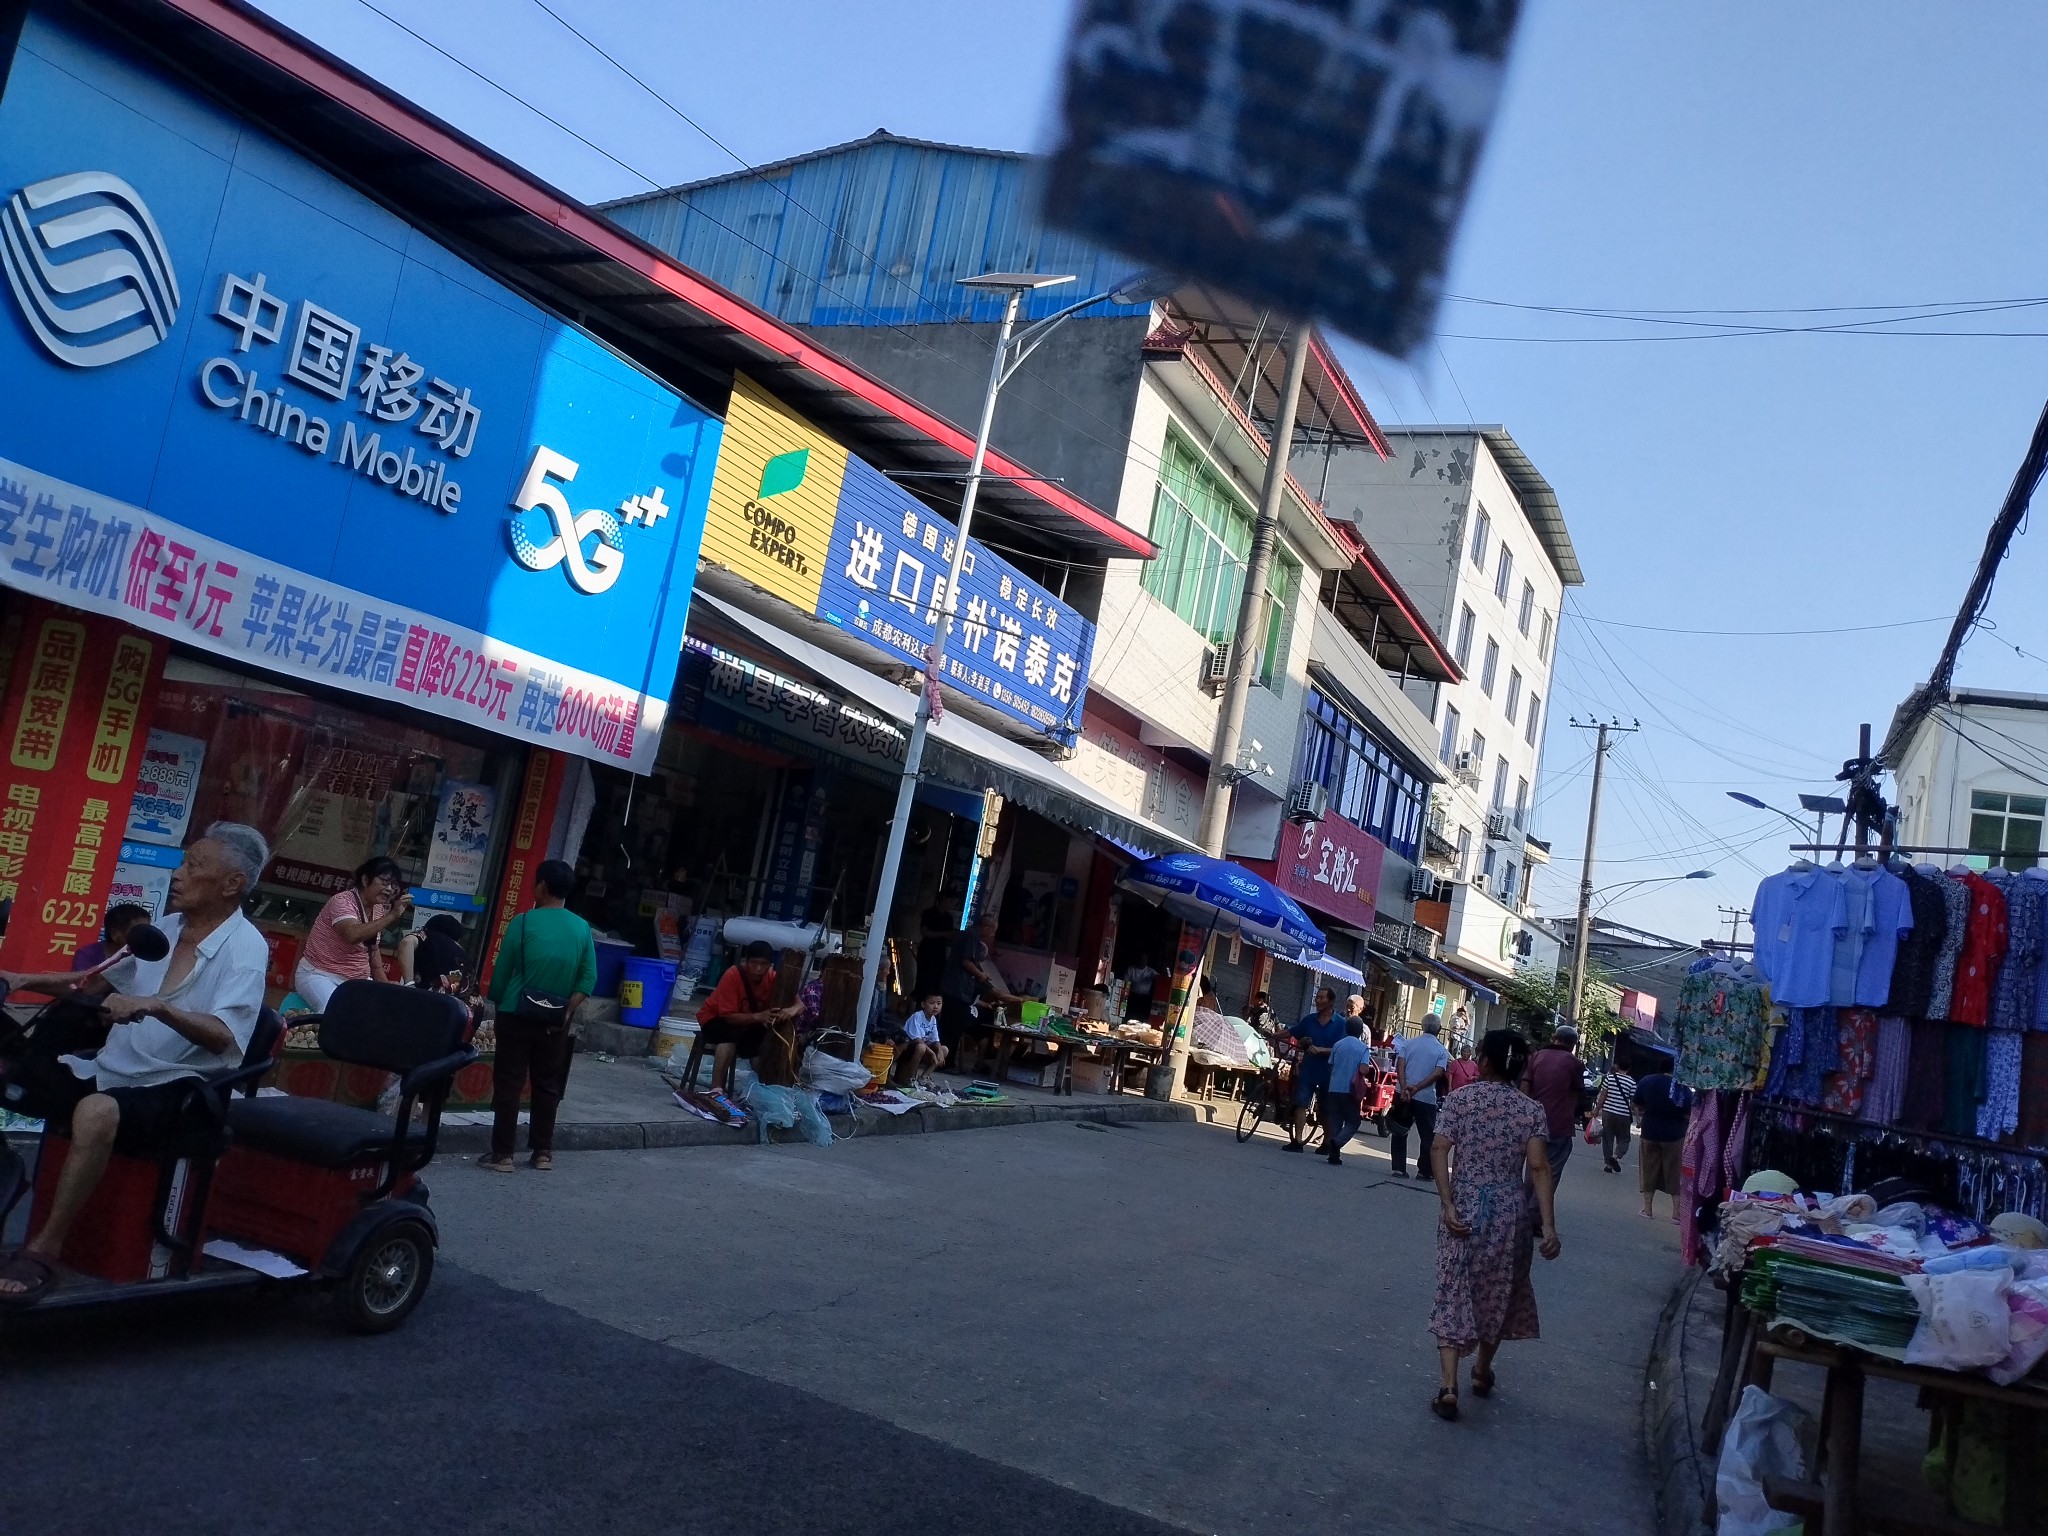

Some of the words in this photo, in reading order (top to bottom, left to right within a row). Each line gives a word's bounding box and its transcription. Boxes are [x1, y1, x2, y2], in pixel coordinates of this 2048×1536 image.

[216, 271, 483, 459] 中国移动
[201, 357, 331, 455] China
[337, 421, 462, 514] Mobile
[743, 501, 797, 546] COMPO
[241, 573, 518, 722] 苹果华为最高直降6225元
[515, 666, 641, 760] 再送600G流量
[999, 574, 1059, 631] 稳定长效
[18, 628, 78, 761] 品质宽带
[92, 643, 146, 776] 购5G手机
